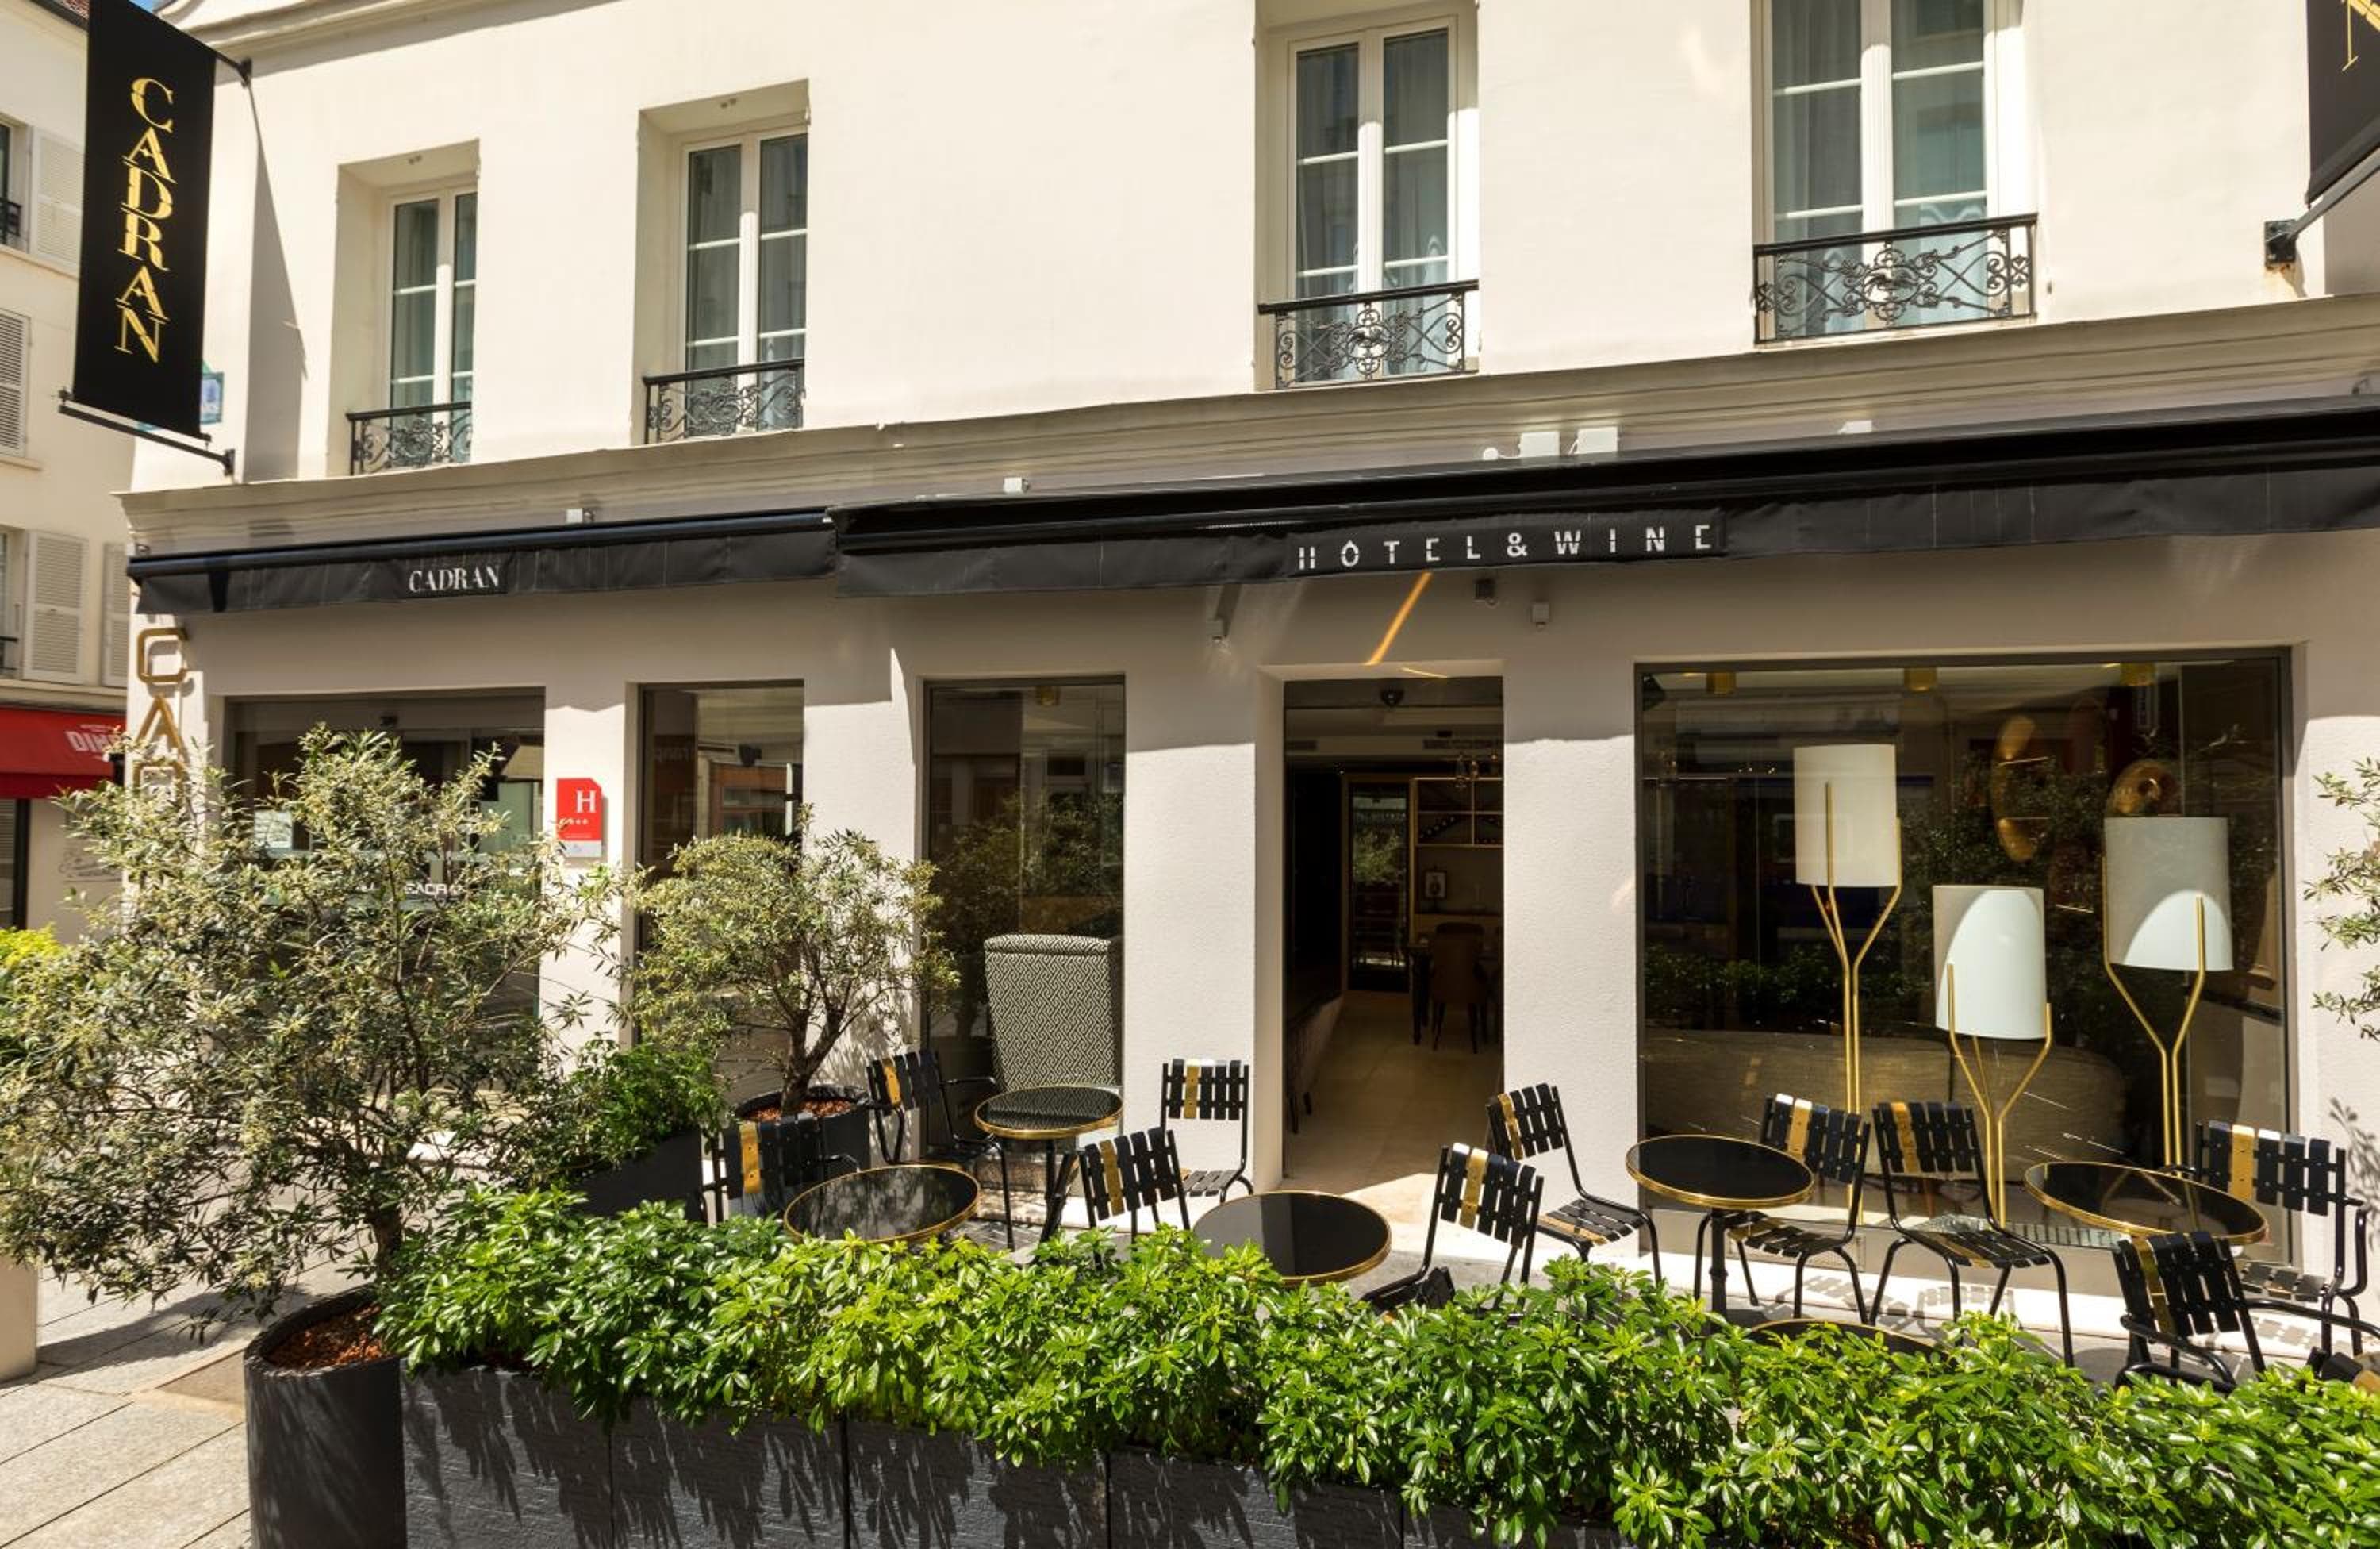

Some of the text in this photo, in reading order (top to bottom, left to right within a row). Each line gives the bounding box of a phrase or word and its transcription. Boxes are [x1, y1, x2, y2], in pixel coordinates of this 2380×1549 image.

[114, 77, 177, 363] CADRAN
[1507, 532, 1528, 557] &
[1554, 524, 1711, 555] WINE
[409, 564, 501, 593] CADRAN
[576, 789, 597, 813] H
